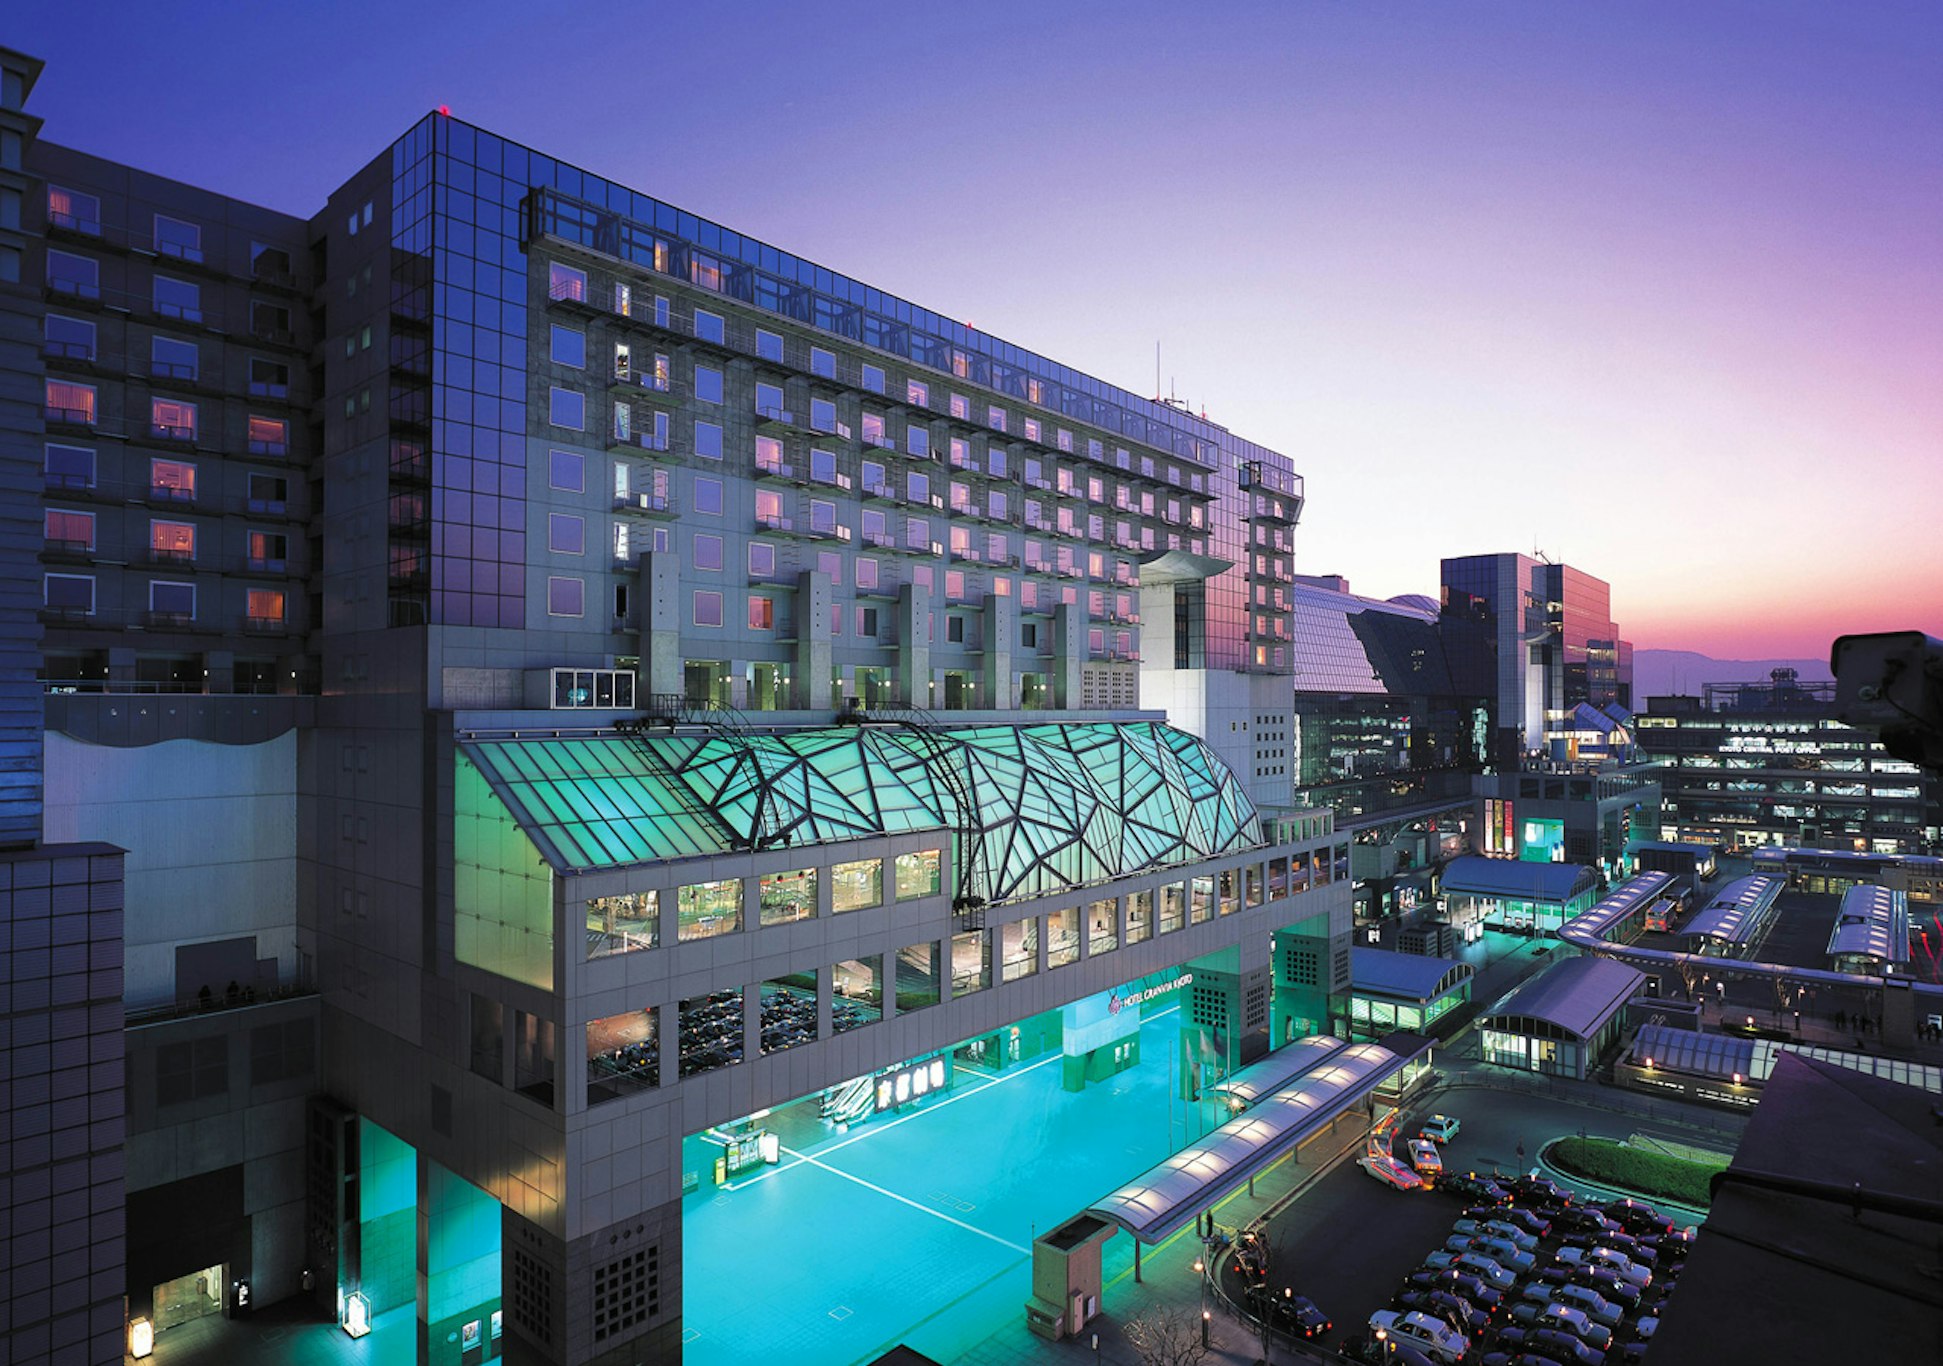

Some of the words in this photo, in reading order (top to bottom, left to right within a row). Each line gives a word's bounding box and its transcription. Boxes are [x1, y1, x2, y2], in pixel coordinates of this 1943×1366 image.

[1743, 746, 1774, 754] CENTRAL
[1124, 992, 1143, 1006] HOTEL
[1173, 974, 1193, 988] KYOTO
